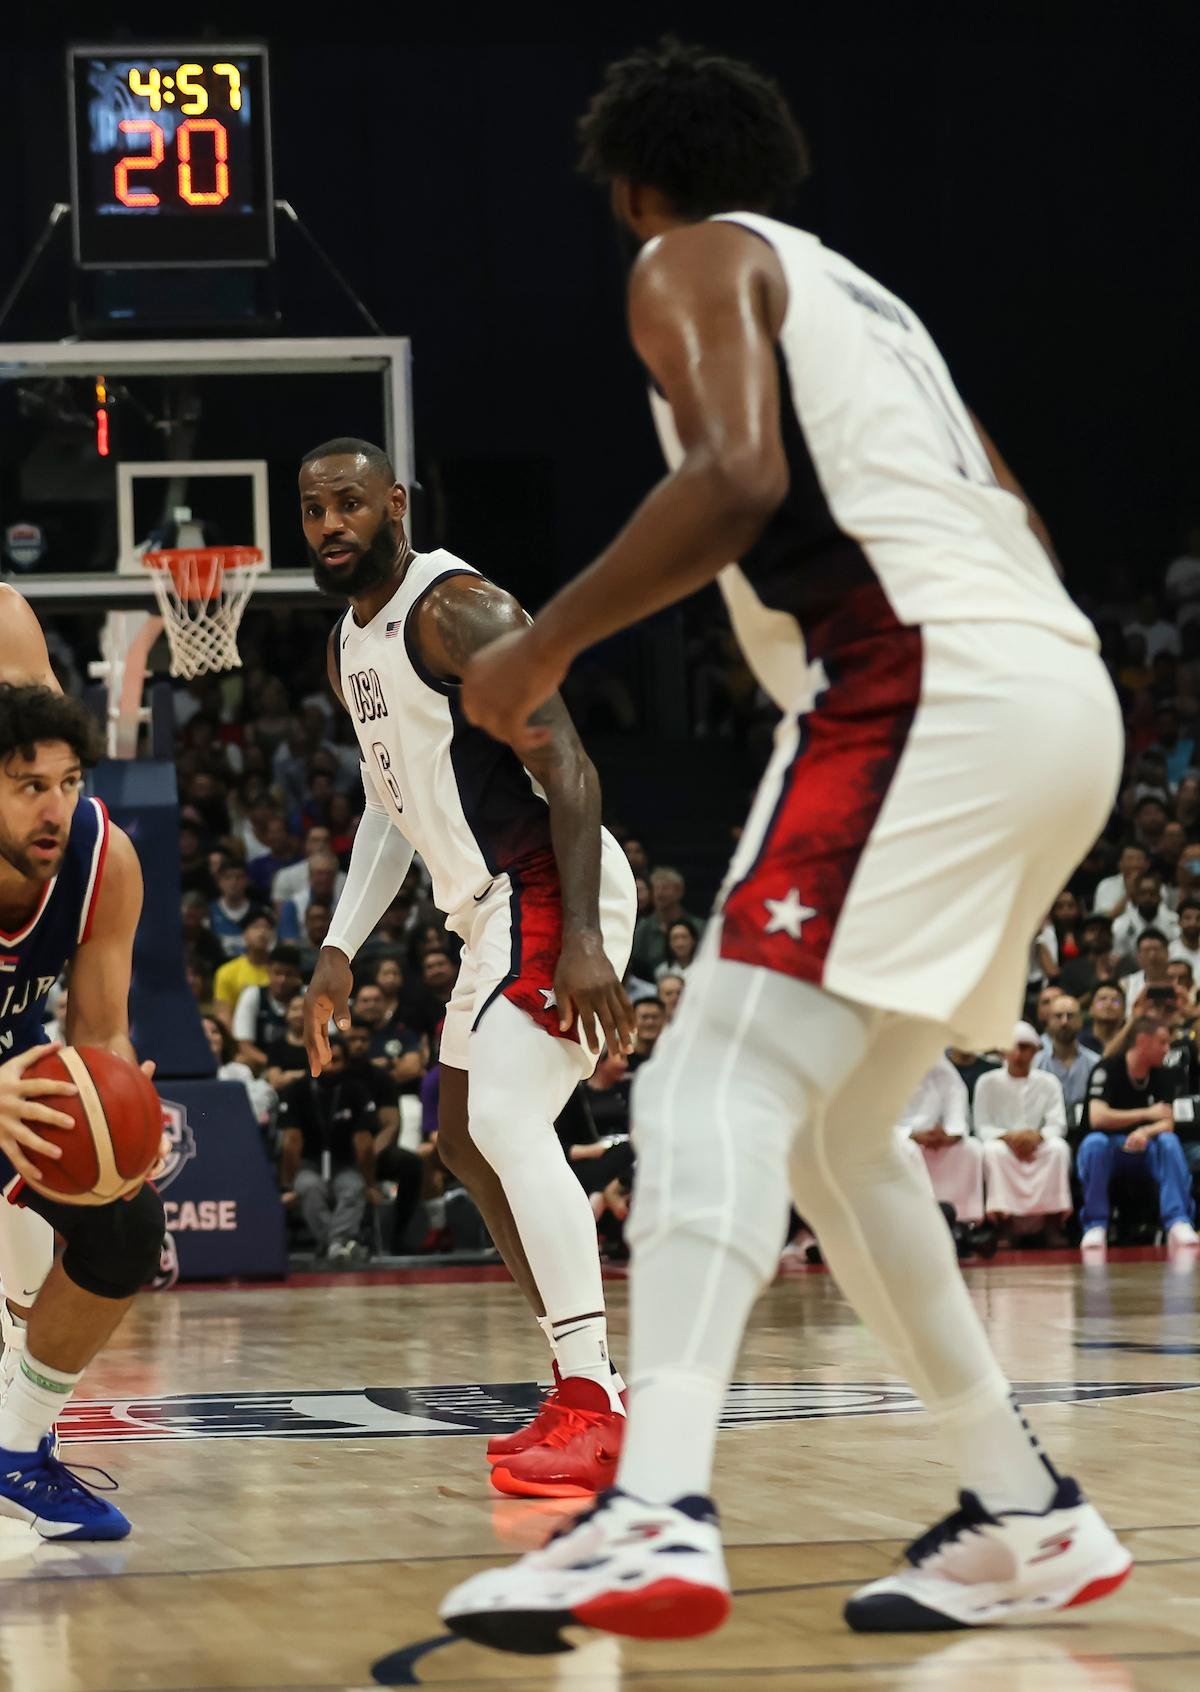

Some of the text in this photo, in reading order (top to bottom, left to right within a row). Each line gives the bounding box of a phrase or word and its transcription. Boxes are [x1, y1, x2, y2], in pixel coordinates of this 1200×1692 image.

[129, 63, 242, 115] 4:57
[114, 118, 230, 207] 20
[348, 668, 388, 723] USA
[372, 741, 403, 813] 6
